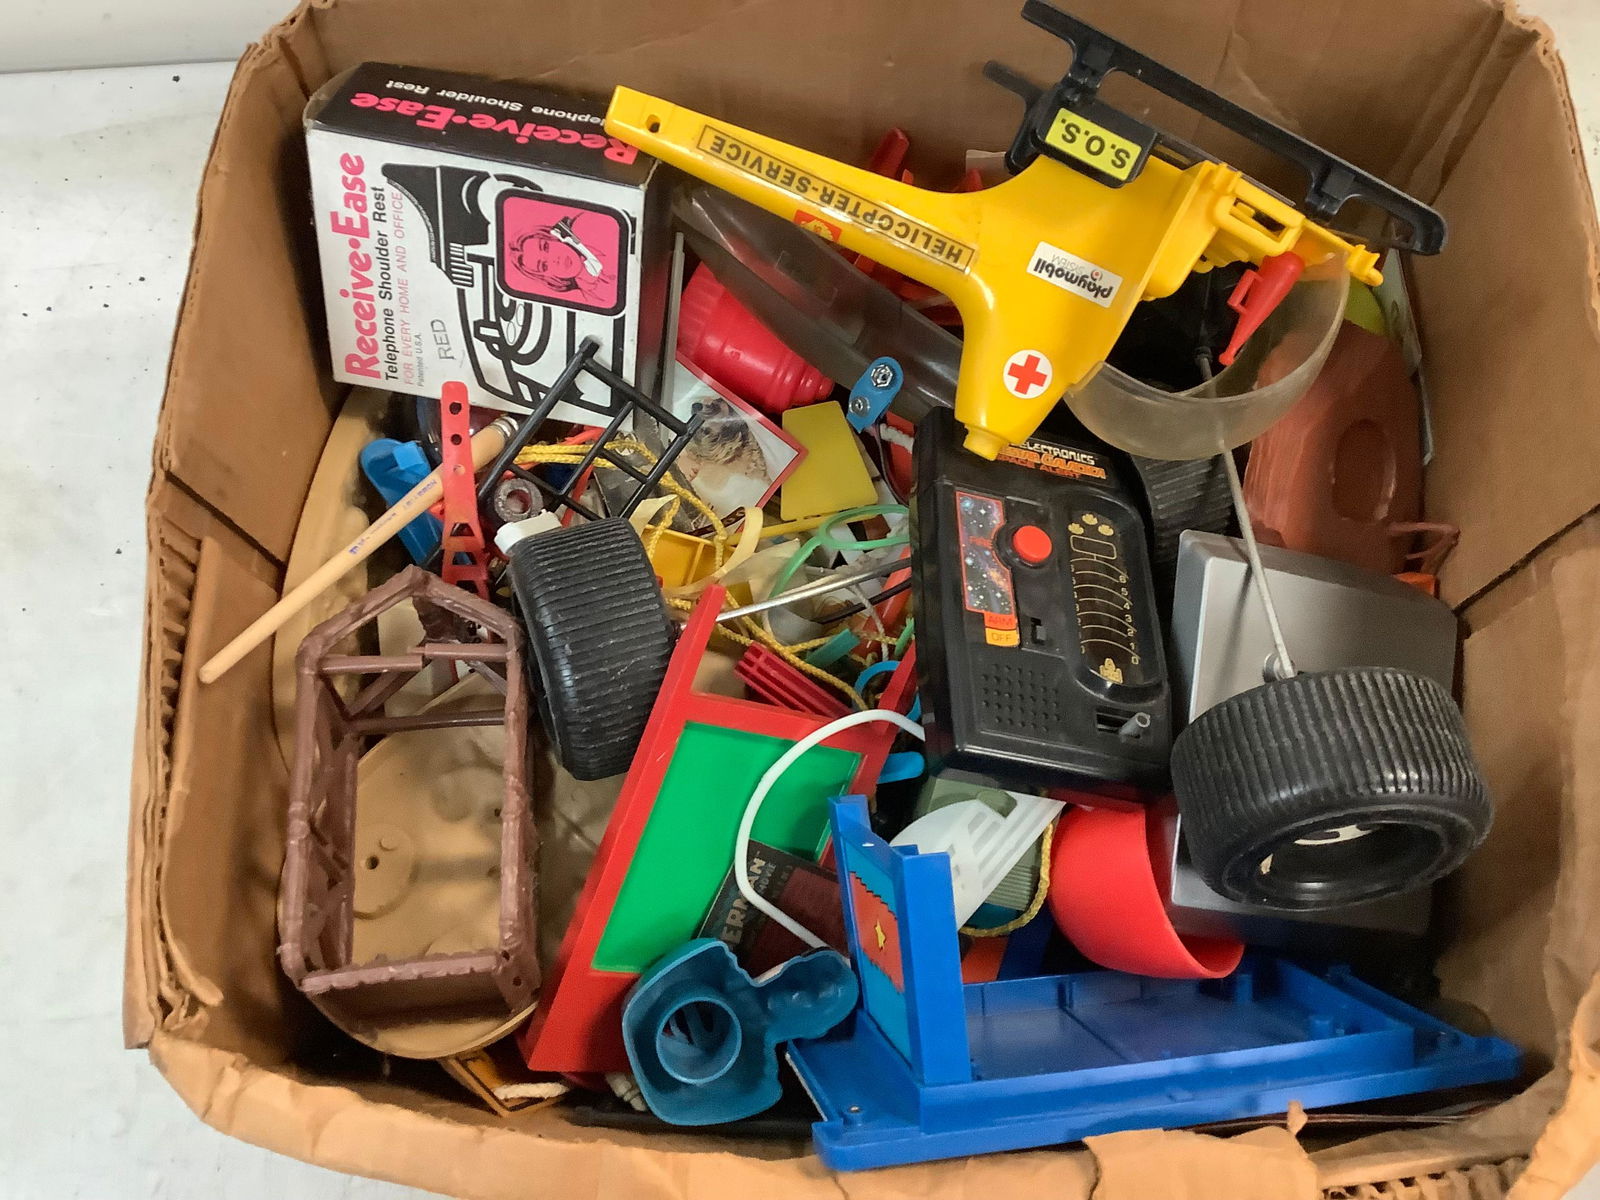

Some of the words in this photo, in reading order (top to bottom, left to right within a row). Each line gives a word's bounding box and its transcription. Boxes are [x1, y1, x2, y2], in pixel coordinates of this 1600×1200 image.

[385, 79, 430, 95] Rest
[437, 89, 524, 112] Shoulder
[532, 105, 606, 127] lephone
[1060, 117, 1131, 169] S.O.S.
[370, 186, 387, 223] Rest
[711, 134, 963, 264] HELICOPTER-SERVICE
[391, 191, 405, 239] OFFICE
[375, 230, 393, 301] Shoulder
[394, 245, 408, 273] AND
[1033, 257, 1115, 299] playmobil
[397, 278, 410, 314] HOME
[382, 308, 400, 380] Telephone
[399, 319, 413, 357] EVERY
[430, 319, 457, 361] RED
[403, 362, 415, 385] FOR
[1119, 575, 1127, 584] 6
[1121, 587, 1129, 596] 5
[1123, 602, 1130, 610] 4
[1125, 614, 1133, 623] 3
[991, 631, 1012, 643] OFF
[1127, 628, 1134, 637] 2
